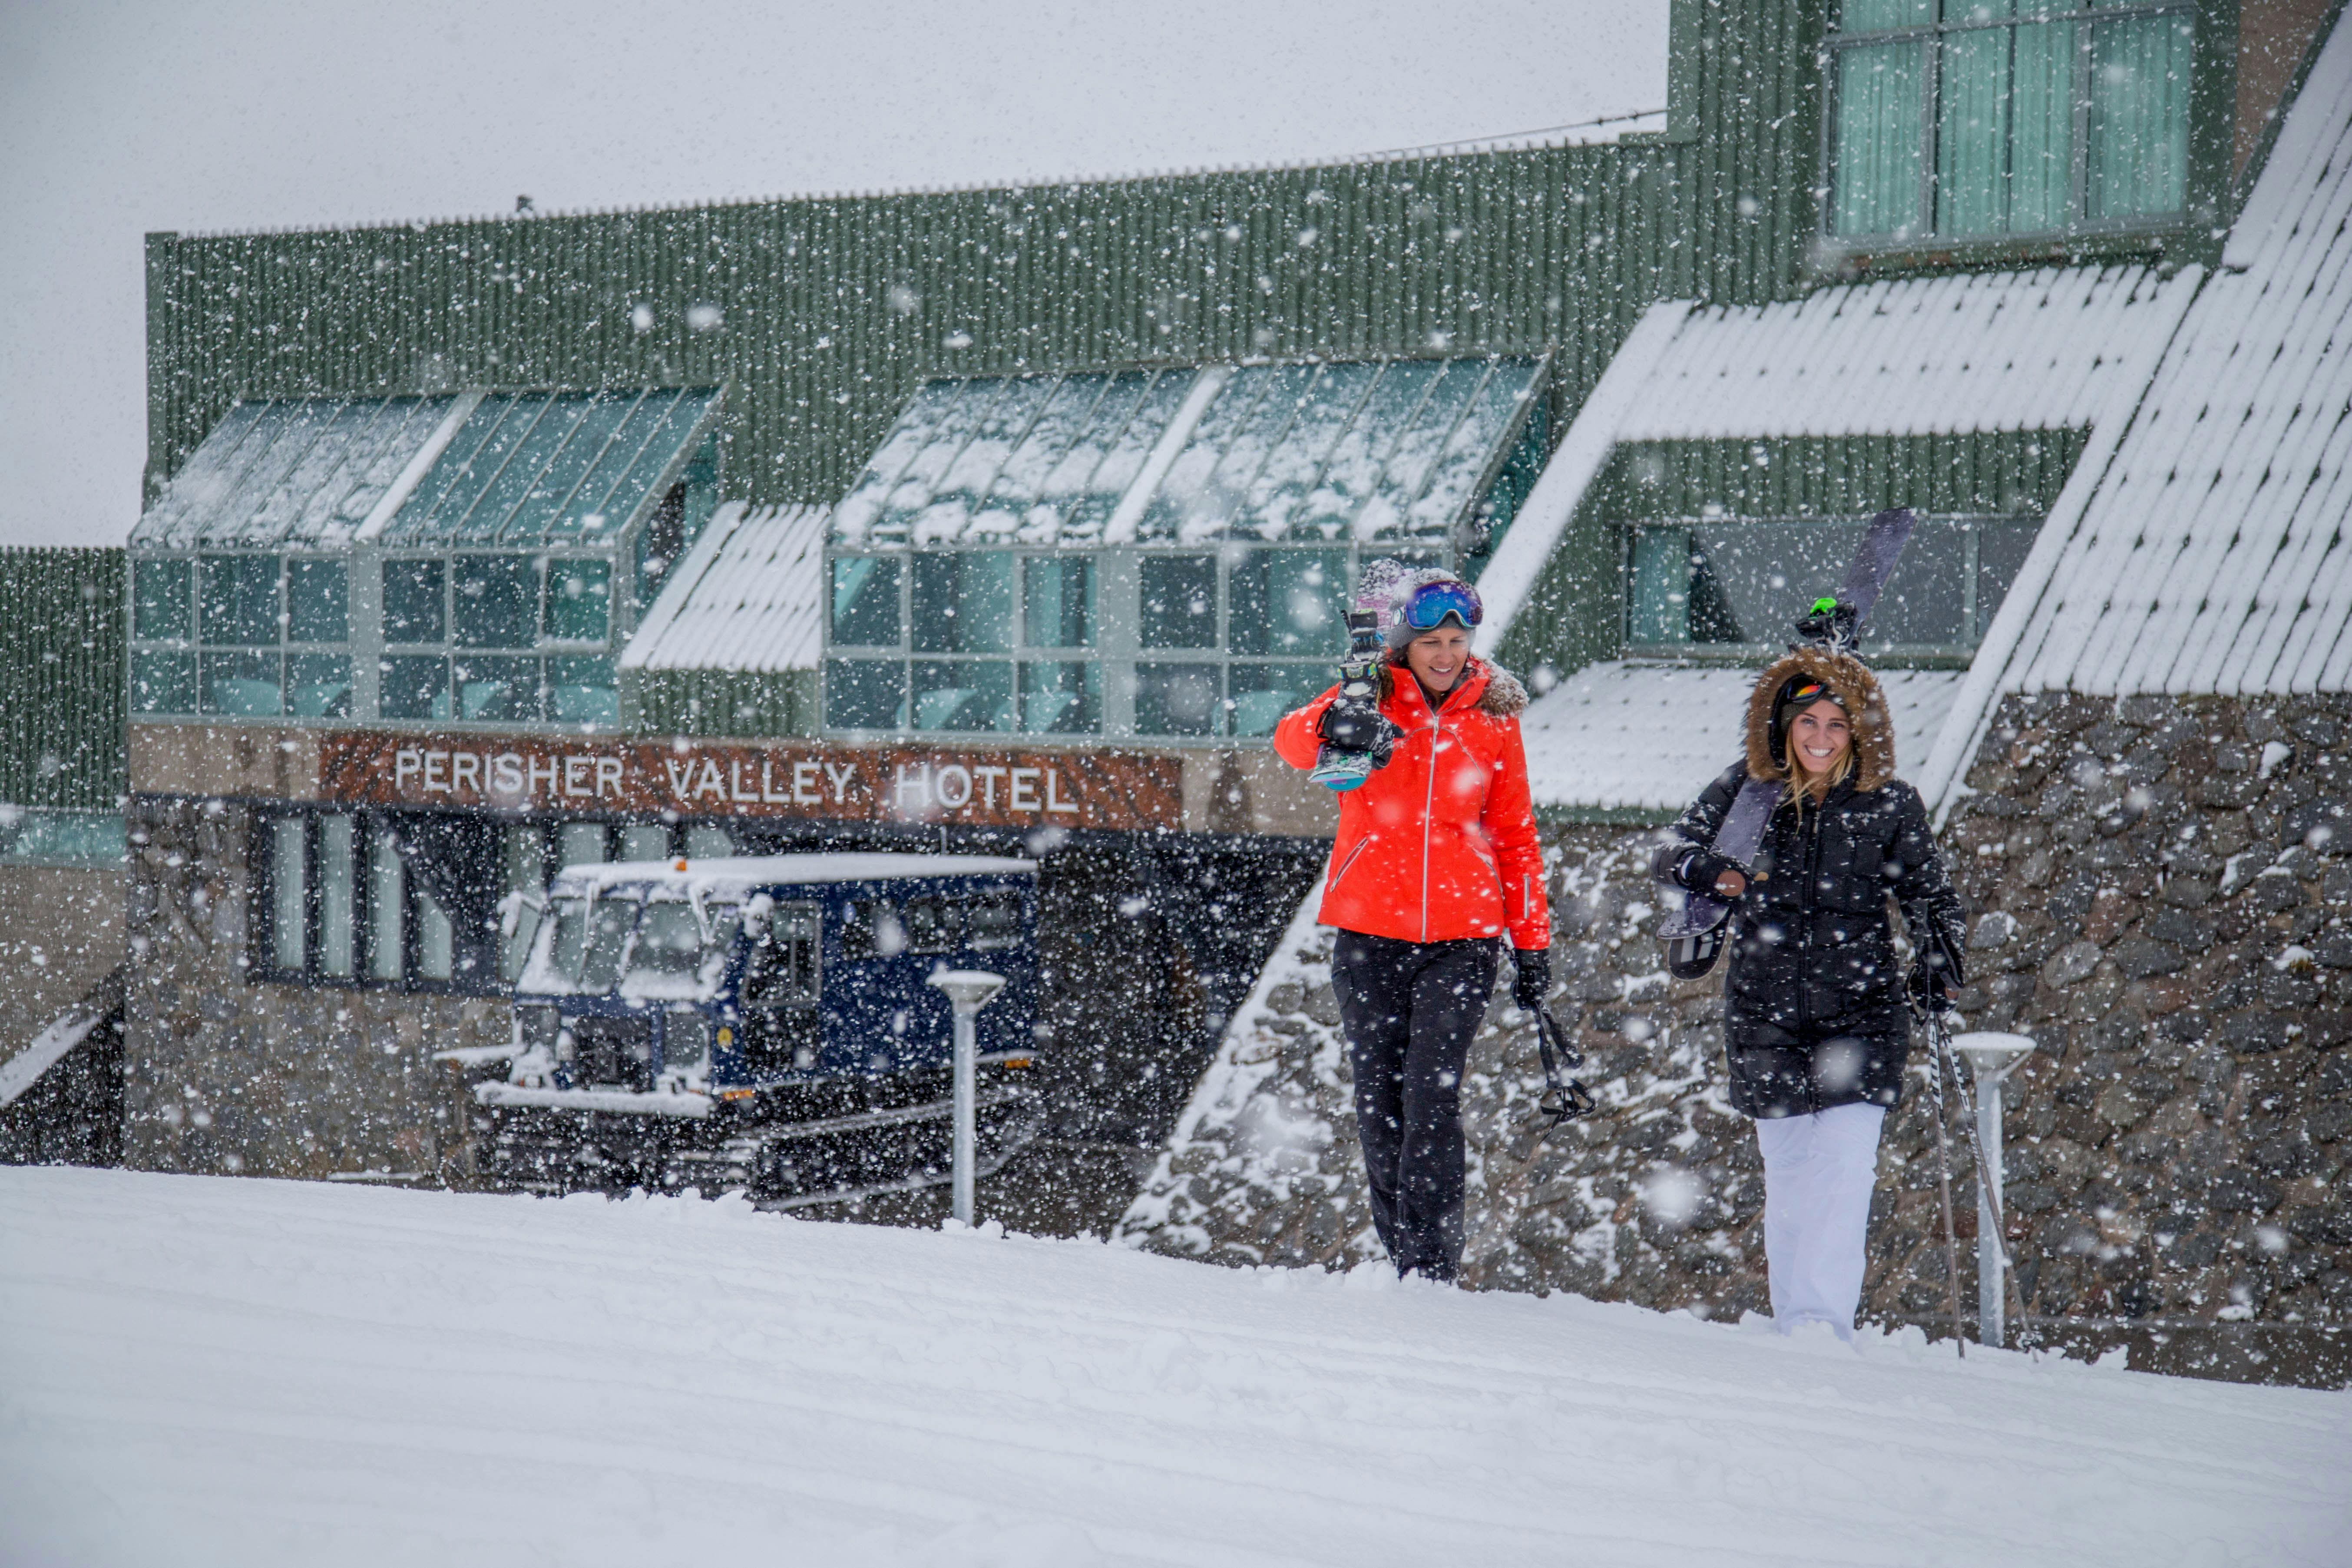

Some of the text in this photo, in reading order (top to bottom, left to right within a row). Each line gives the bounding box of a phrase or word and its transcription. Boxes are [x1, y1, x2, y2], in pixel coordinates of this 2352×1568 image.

[394, 749, 1079, 813] PERISHER VALLEY HOTEL
